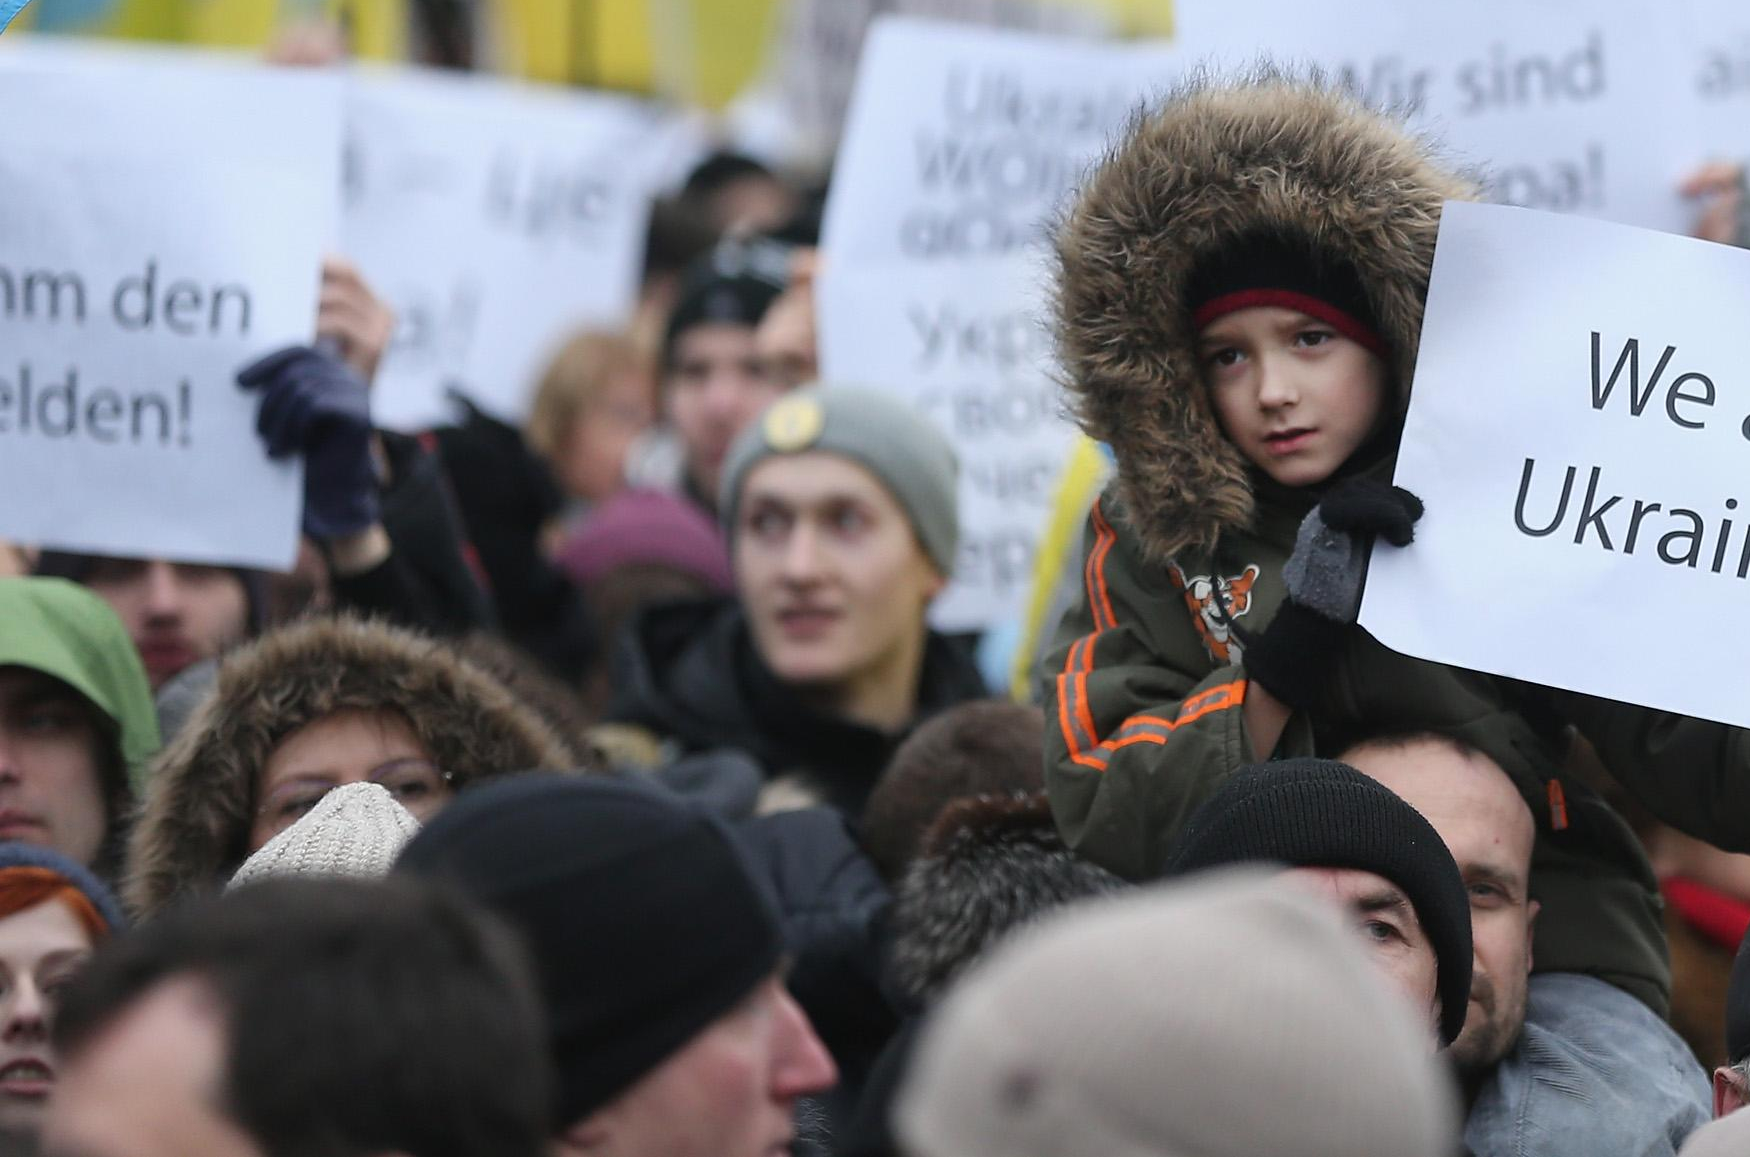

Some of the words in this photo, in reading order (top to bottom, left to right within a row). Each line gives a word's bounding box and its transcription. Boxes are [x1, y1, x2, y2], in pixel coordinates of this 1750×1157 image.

[1455, 25, 1608, 119] sind
[112, 256, 254, 339] den
[1590, 330, 1717, 430] We
